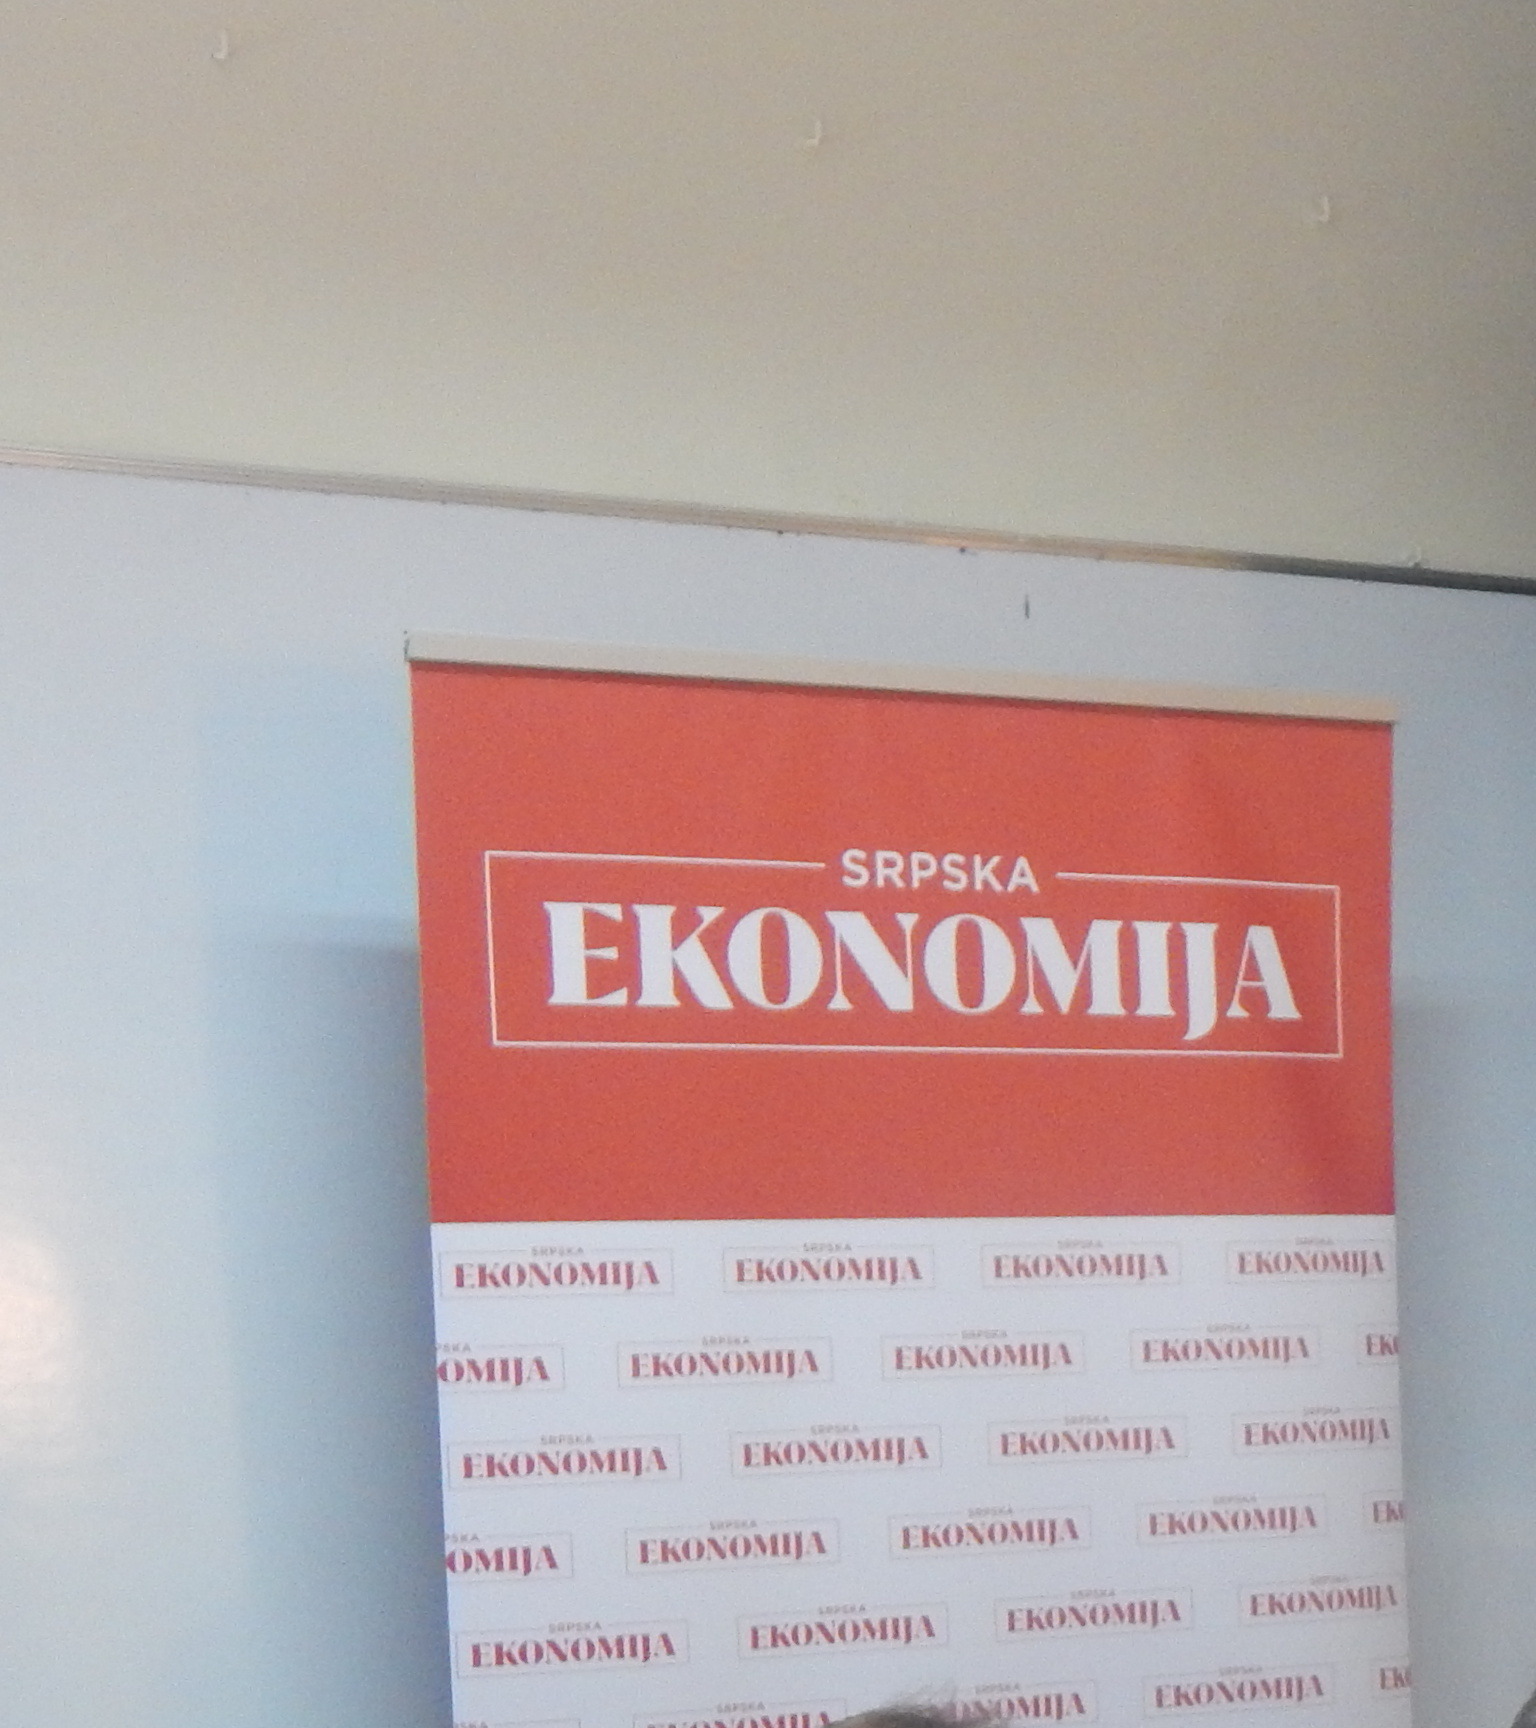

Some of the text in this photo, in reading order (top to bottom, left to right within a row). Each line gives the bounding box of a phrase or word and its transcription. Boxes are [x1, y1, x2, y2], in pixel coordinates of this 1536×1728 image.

[842, 848, 1040, 894] SRPSKA
[542, 901, 1302, 1042] EKONOMIJA
[454, 1261, 660, 1290] EKONOMIJA
[735, 1256, 922, 1286] EKONOMIJA
[993, 1252, 1168, 1281] EKONOMIJA
[1237, 1250, 1385, 1277] EKONOMIJA
[630, 1348, 819, 1379] EKONOMIJA
[894, 1341, 1073, 1371] EKONOMIJA
[1141, 1336, 1310, 1363] EKONOMIJA
[436, 1356, 550, 1387] OMIJA
[1000, 1426, 1175, 1456] EKONOMIJA
[1243, 1418, 1391, 1446] EKONOMIJA
[461, 1446, 668, 1480] EKONOMIJA
[742, 1436, 929, 1469] EKONOMIJA
[901, 1517, 1079, 1550] EKONOMIJA
[1149, 1505, 1317, 1535] EKONOMIJA
[445, 1545, 558, 1576] OMIJA
[638, 1530, 826, 1565] EKONOMIJA
[1006, 1598, 1181, 1632] EKONOMIJA
[1249, 1583, 1398, 1617] EKONOMIJA
[750, 1614, 936, 1650] EKONOMIJA
[470, 1631, 676, 1669] EKONOMIJA
[1154, 1673, 1325, 1709] EKONOMIJA
